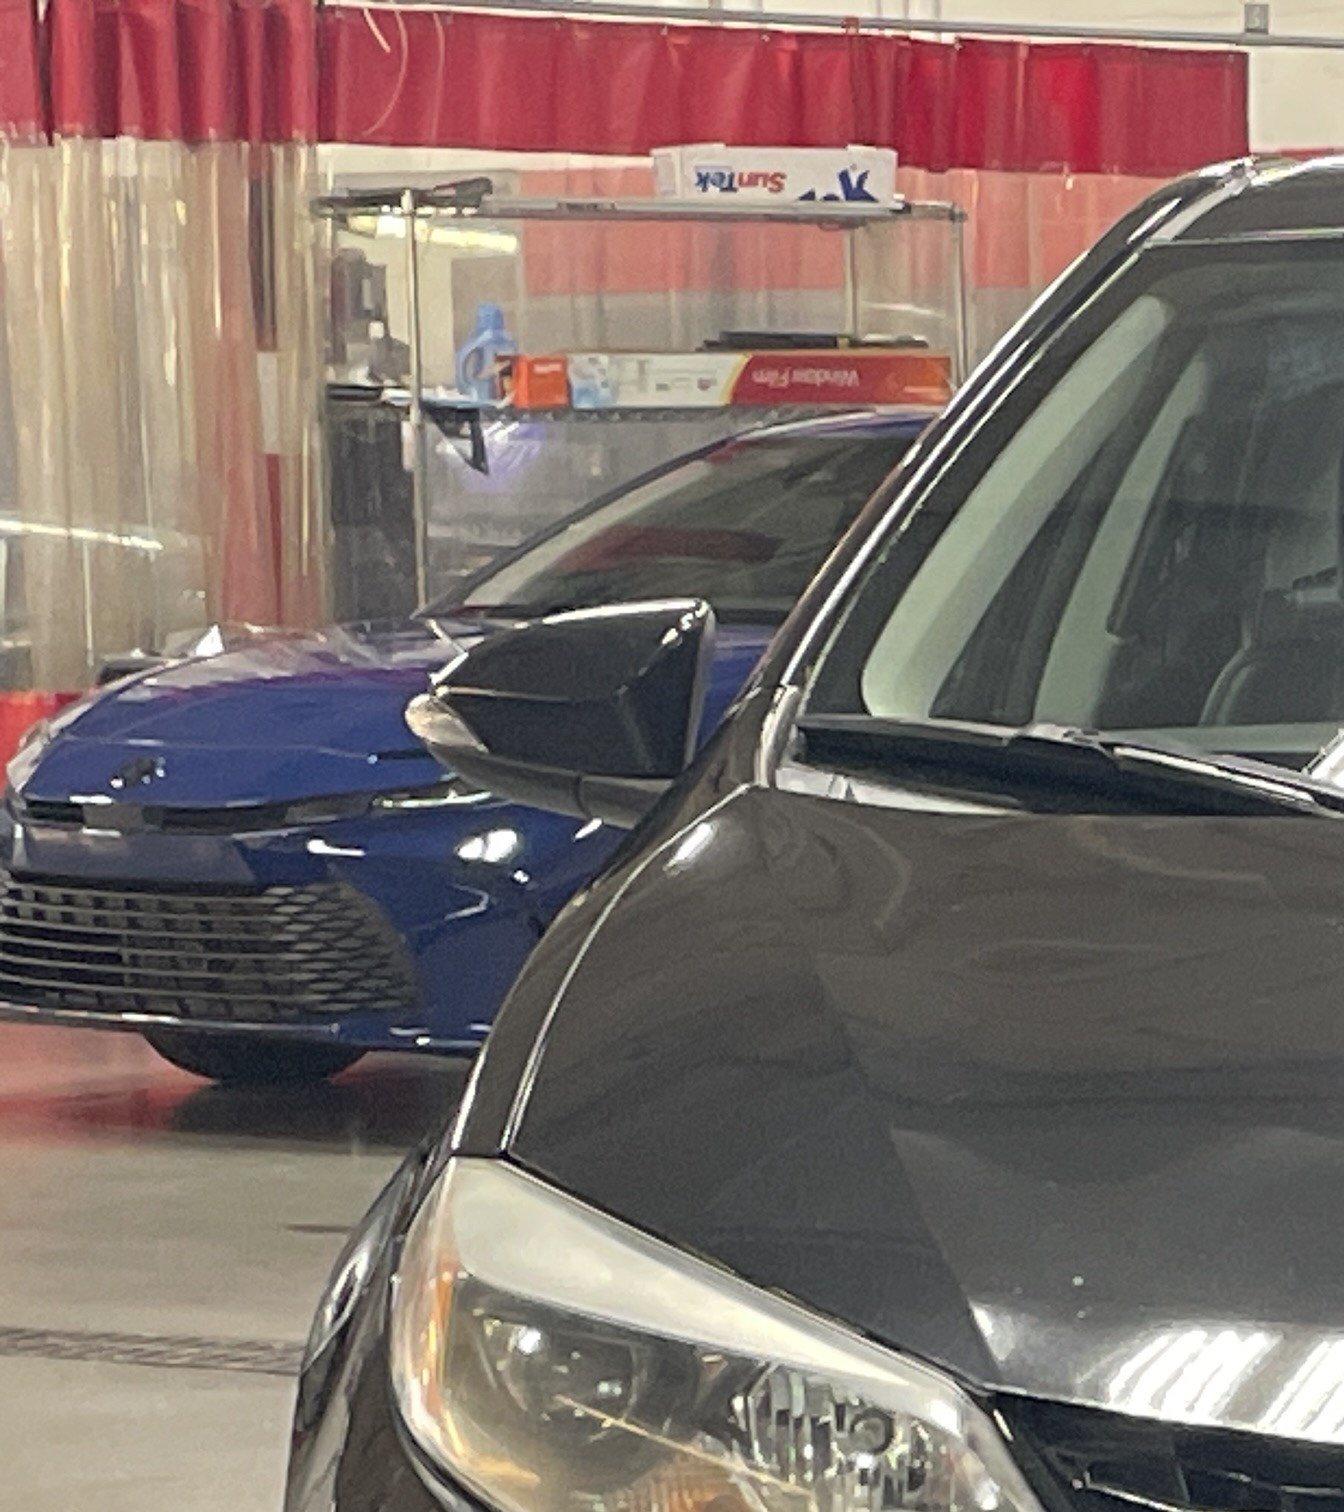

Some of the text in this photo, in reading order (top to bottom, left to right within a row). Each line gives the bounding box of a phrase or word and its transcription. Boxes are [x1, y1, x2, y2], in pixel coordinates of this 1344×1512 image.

[695, 171, 787, 193] SunTek
[752, 366, 860, 389] Window Film
